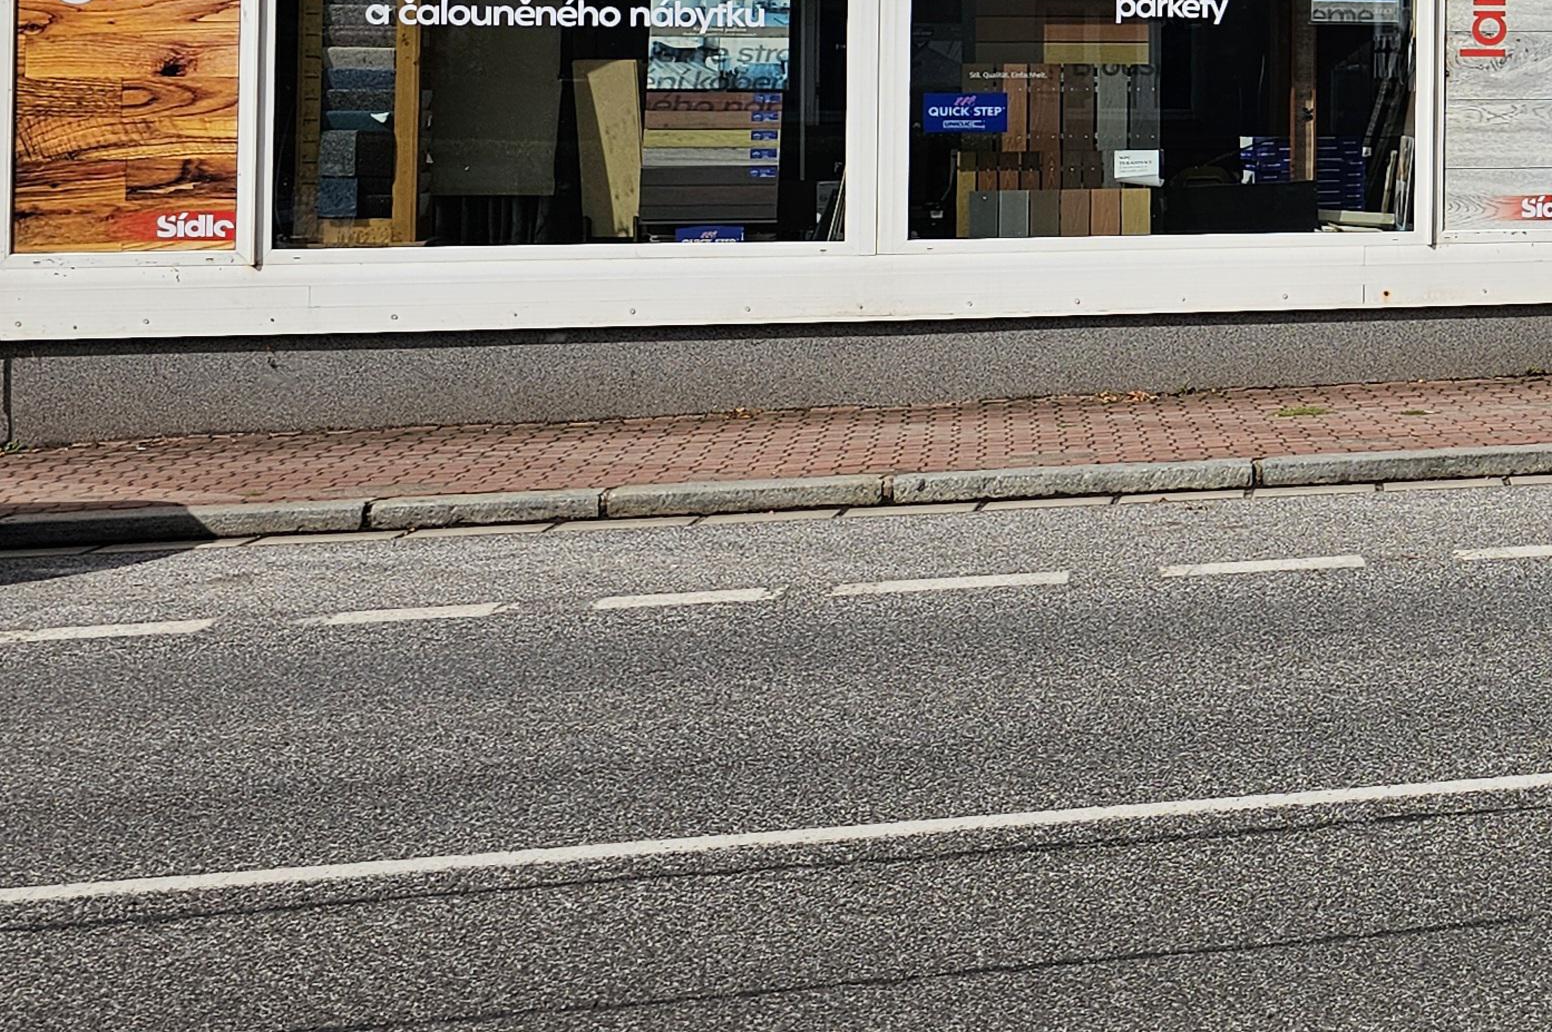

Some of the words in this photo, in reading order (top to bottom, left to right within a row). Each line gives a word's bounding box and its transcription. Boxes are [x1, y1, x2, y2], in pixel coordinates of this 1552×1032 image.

[365, 7, 390, 26] a
[928, 106, 970, 117] QUICK
[973, 106, 1003, 117] STEP
